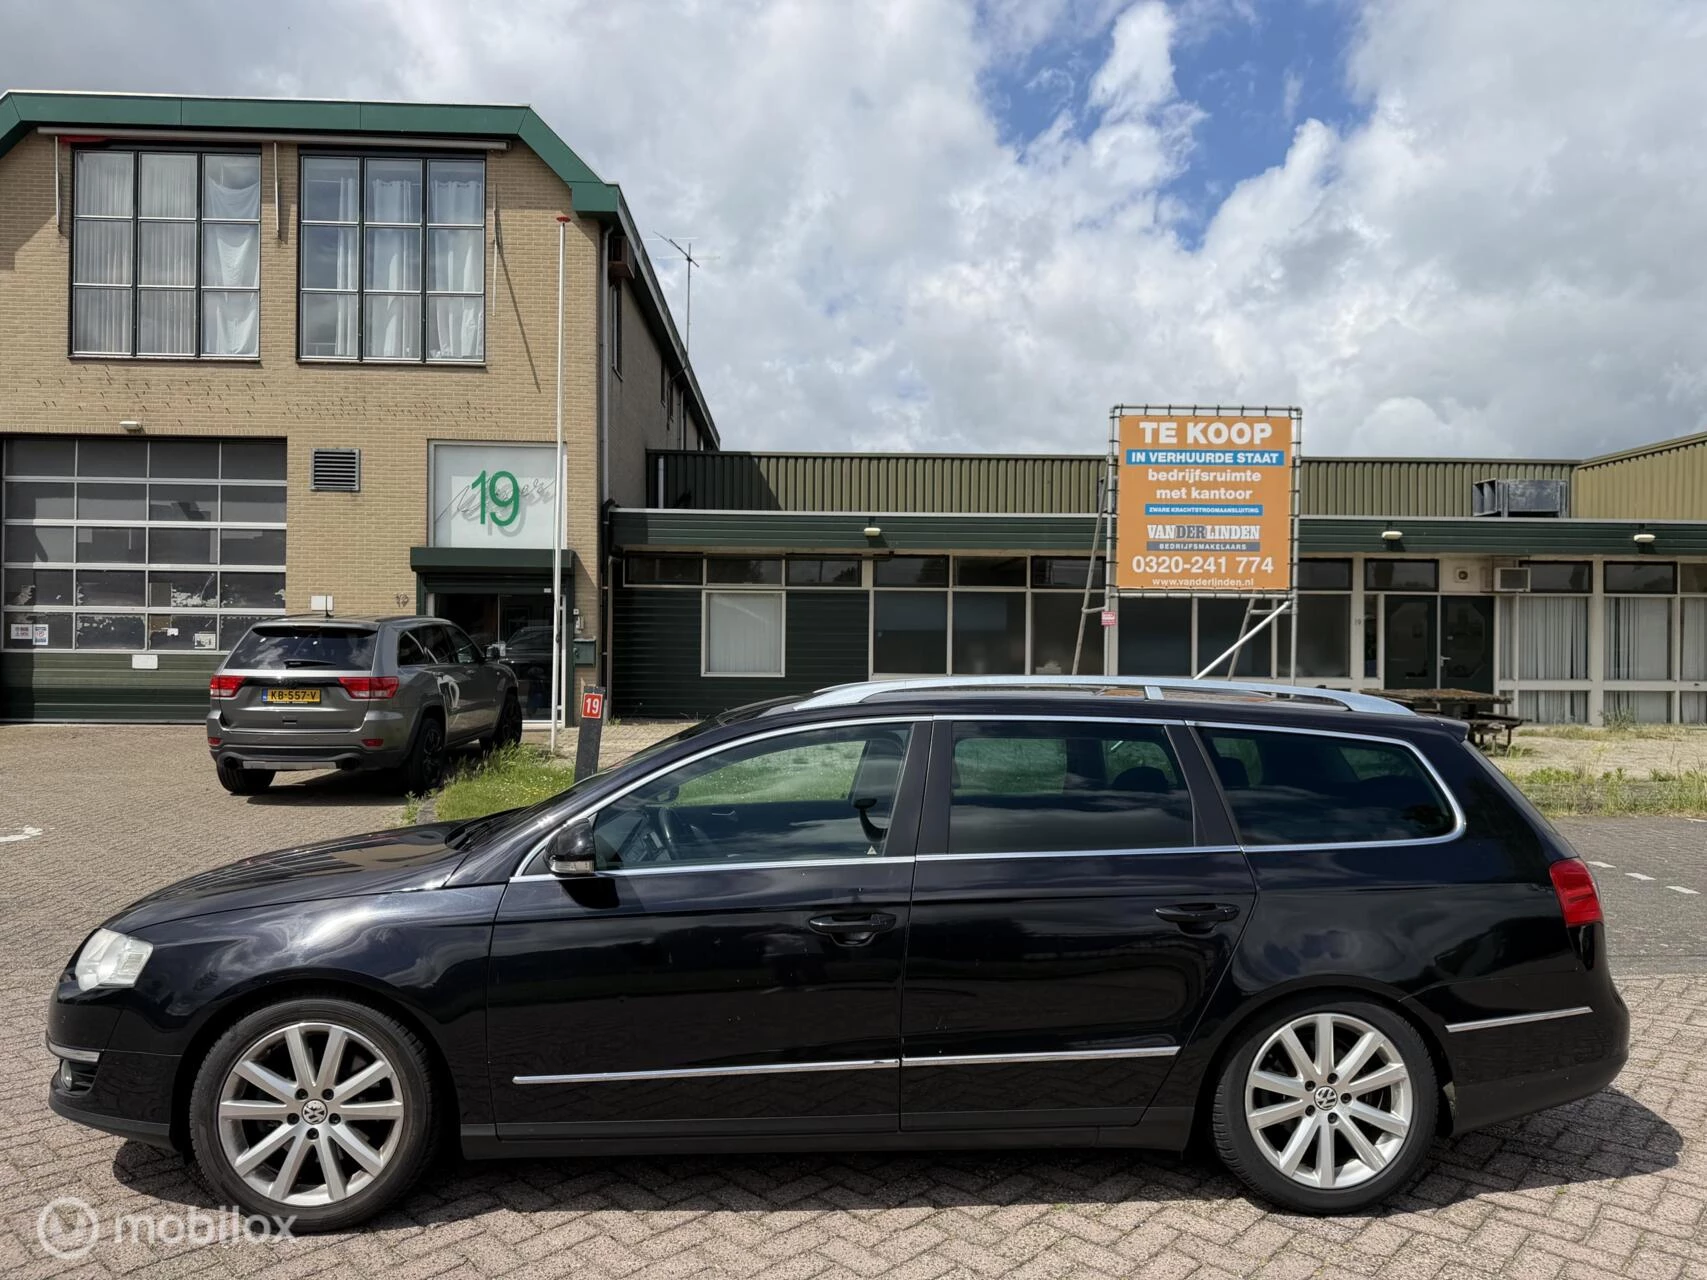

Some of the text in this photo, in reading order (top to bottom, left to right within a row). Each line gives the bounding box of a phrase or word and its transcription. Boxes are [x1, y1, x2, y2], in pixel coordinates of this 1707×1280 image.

[1139, 422, 1272, 444] TE KOOP
[1131, 453, 1279, 463] IN VERHUURDE STAAT
[1148, 469, 1262, 483] bedrijfsruimte
[471, 470, 520, 527] 19
[1156, 487, 1253, 499] met kantoor
[1132, 556, 1274, 573] 0320-241 774
[270, 691, 317, 700] KB-557-V
[585, 698, 599, 714] 19
